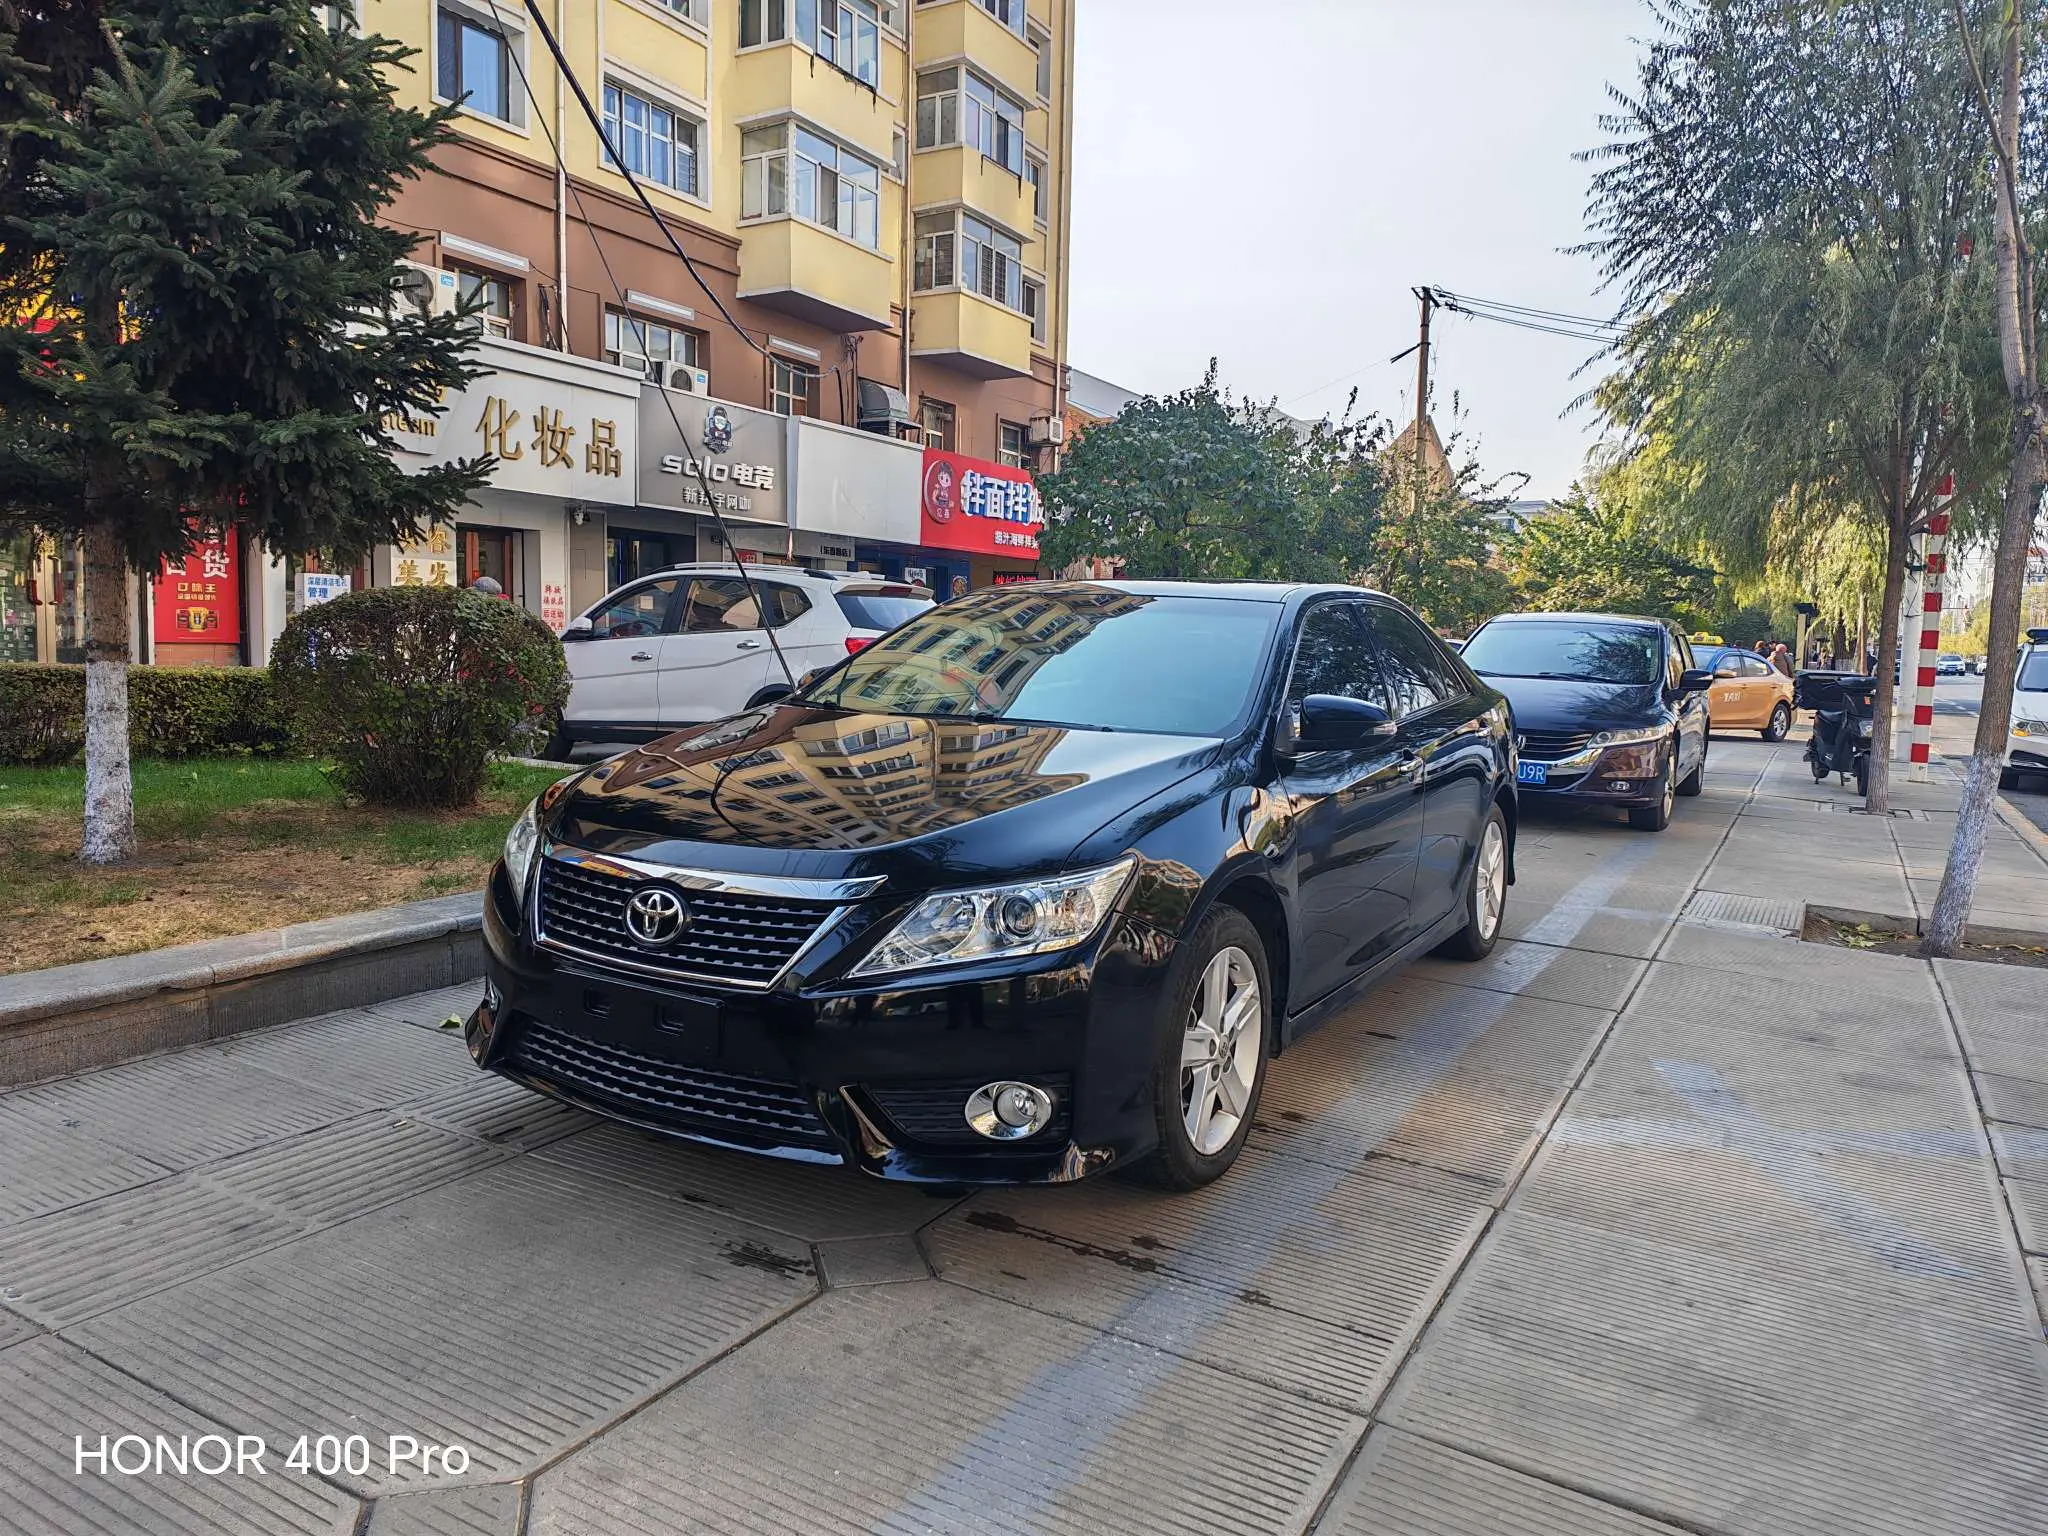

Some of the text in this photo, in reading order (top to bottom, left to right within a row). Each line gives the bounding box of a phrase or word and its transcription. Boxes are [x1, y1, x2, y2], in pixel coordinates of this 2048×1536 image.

[475, 395, 622, 478] 化妆品
[661, 454, 775, 490] solo 电竞
[395, 559, 453, 587] 美发
[307, 586, 329, 599] 管理
